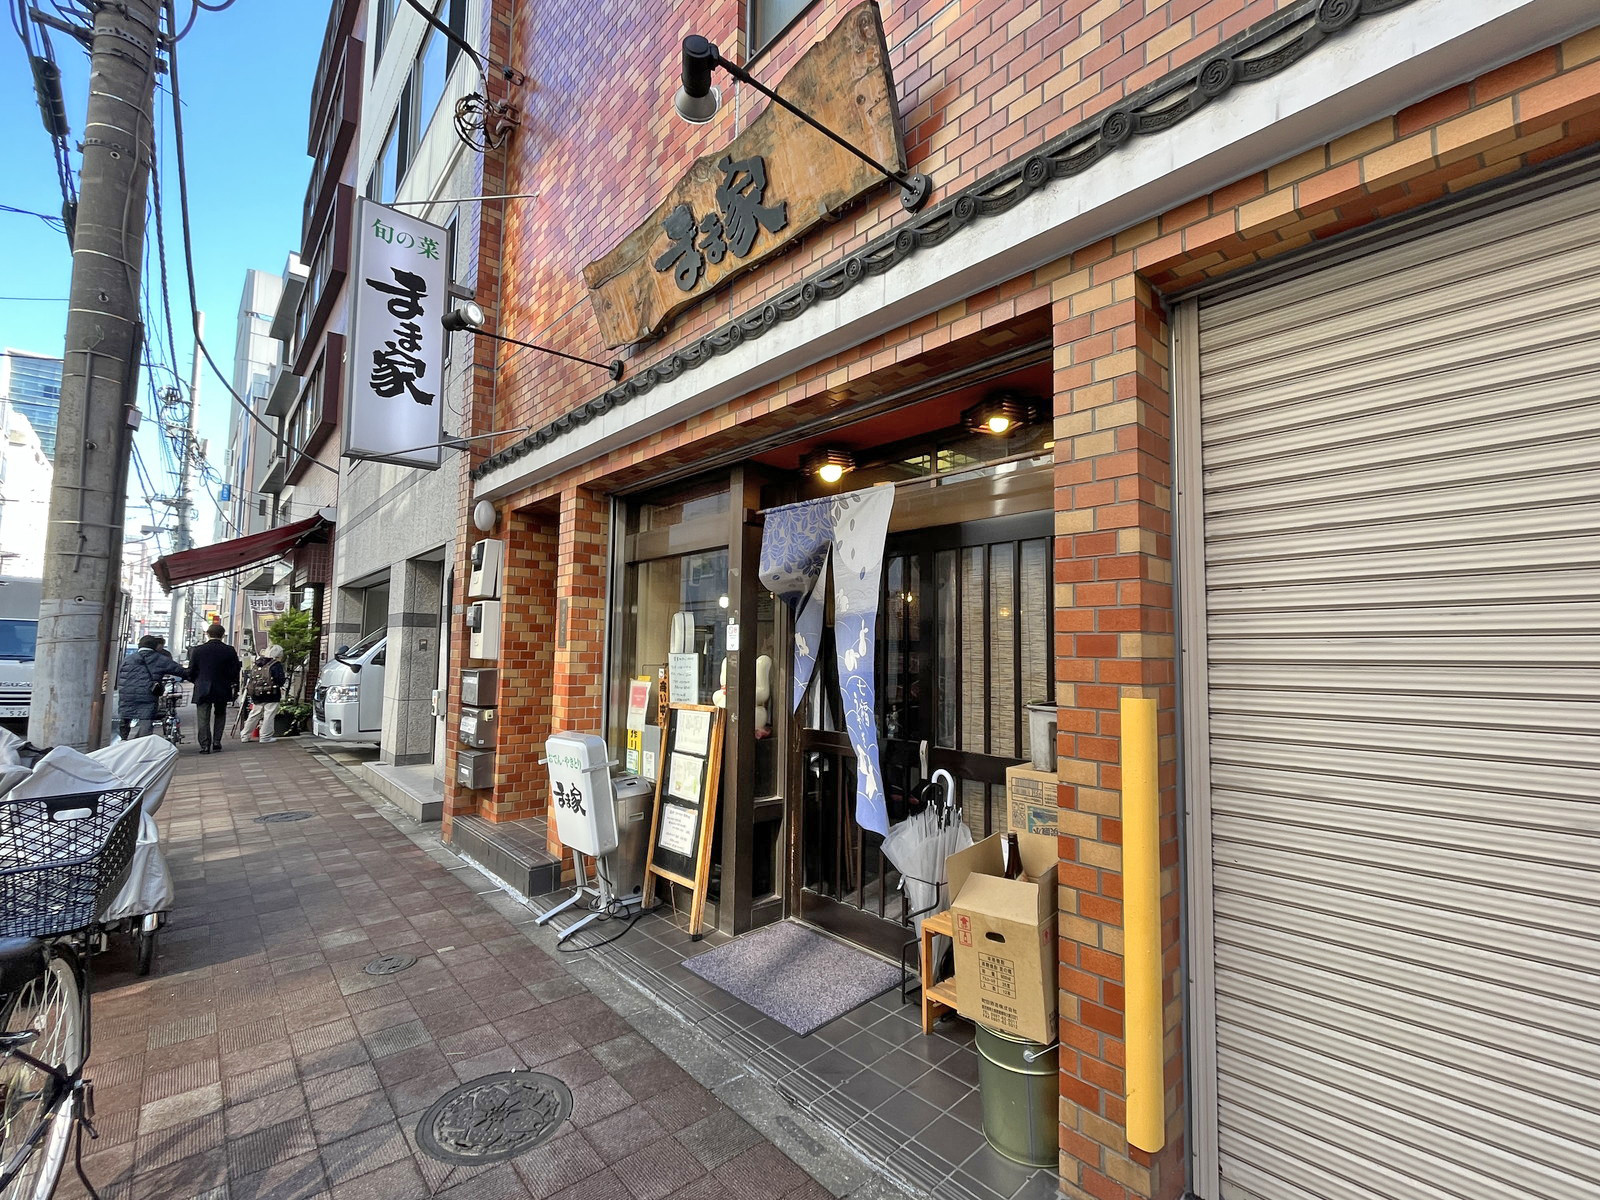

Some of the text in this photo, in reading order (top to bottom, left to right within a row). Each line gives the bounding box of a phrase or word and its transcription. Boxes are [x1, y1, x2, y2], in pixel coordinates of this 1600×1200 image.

[371, 218, 439, 260] 旬の菜
[654, 154, 788, 291] まま家
[365, 266, 436, 406] まま家
[553, 781, 586, 817] まま家
